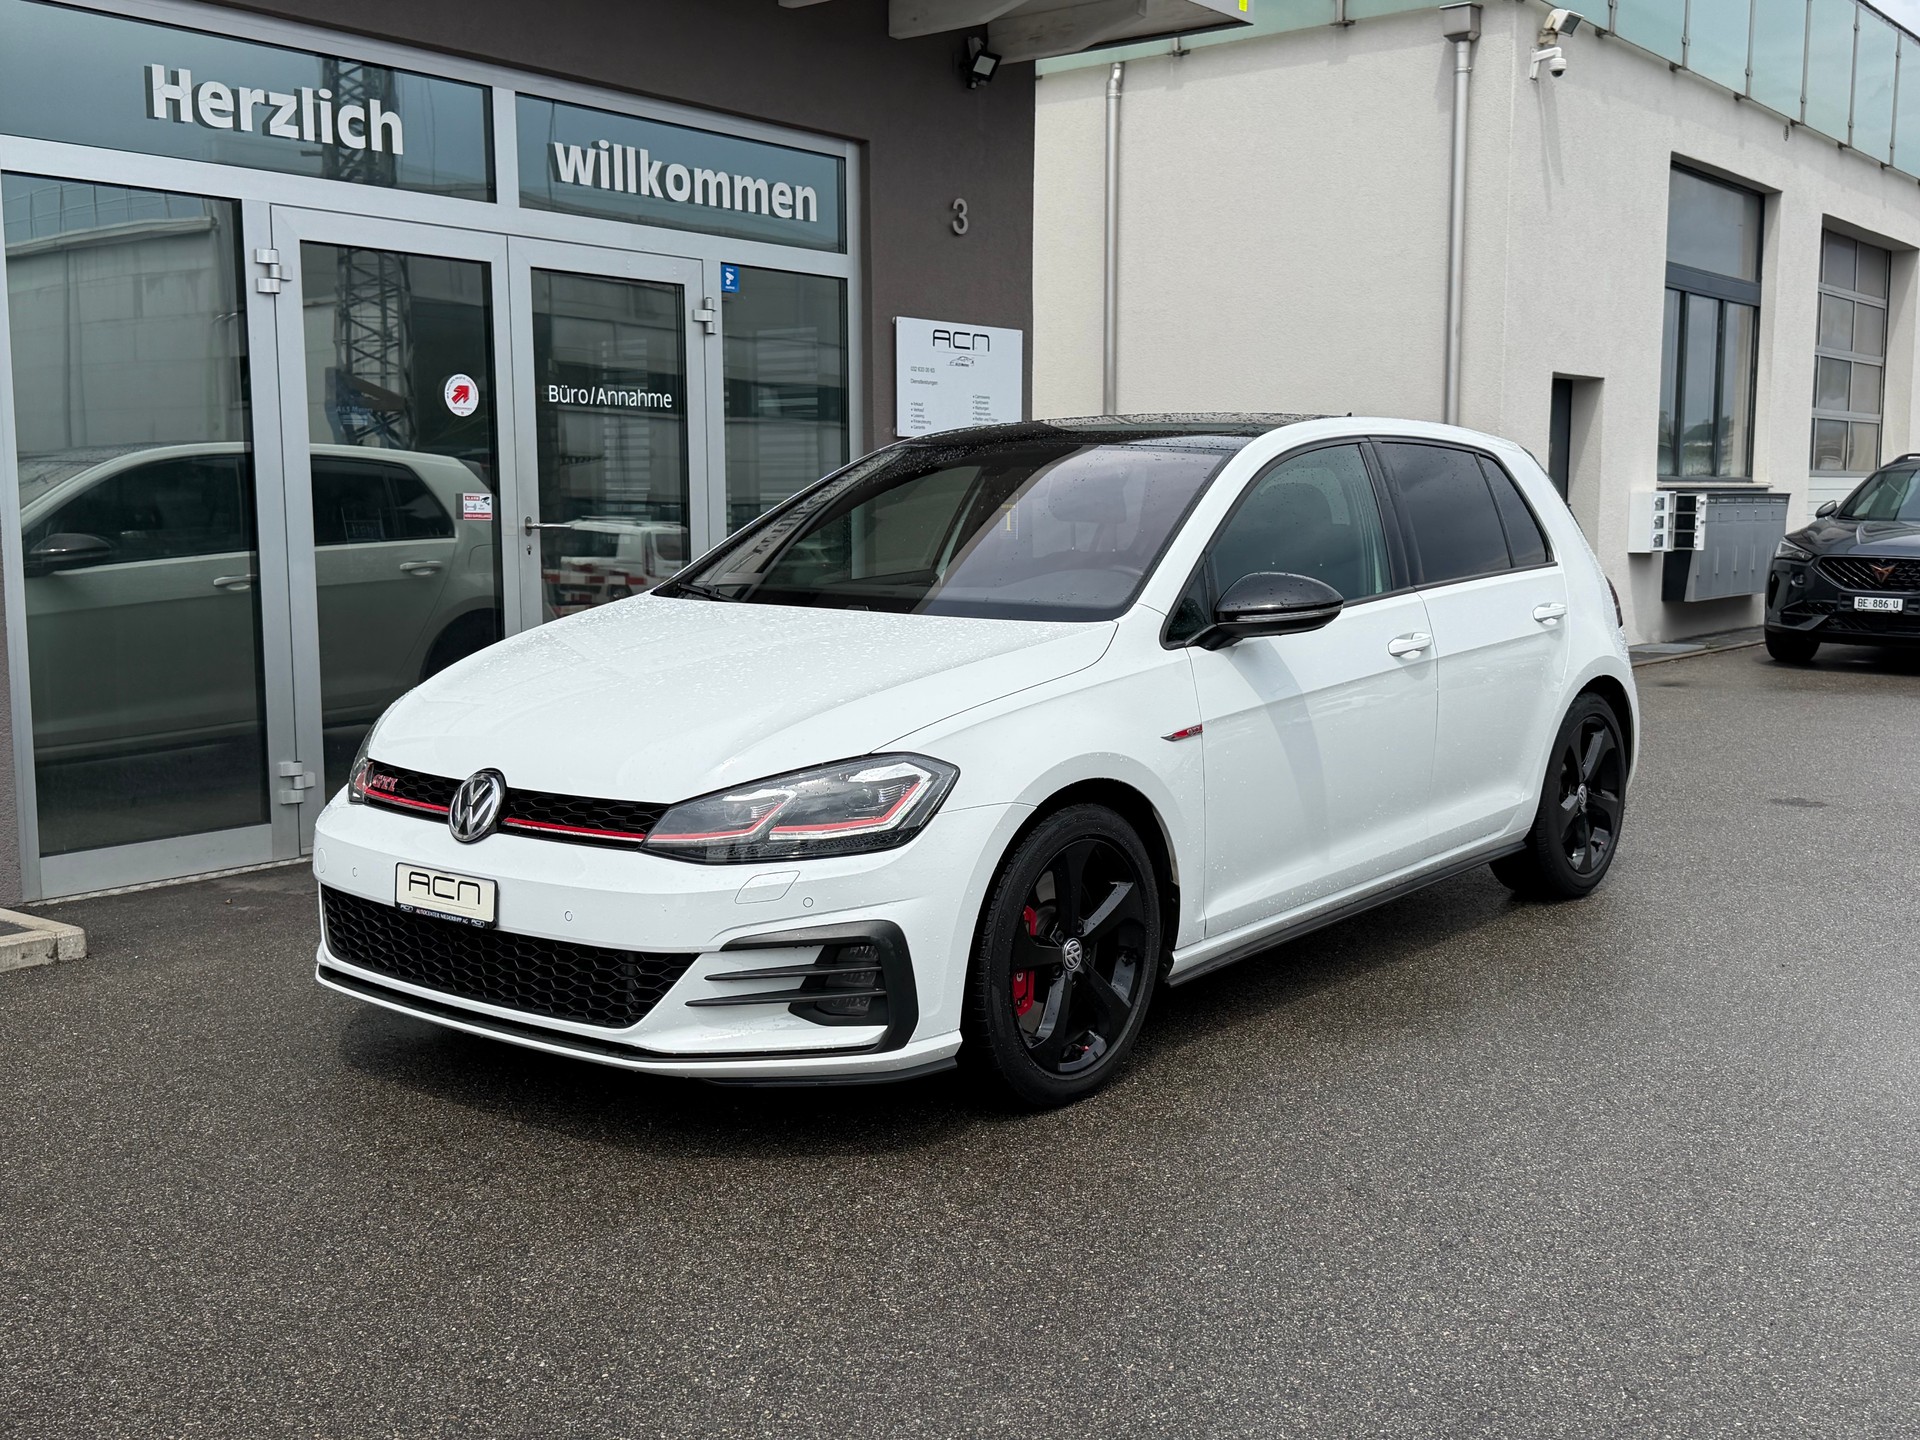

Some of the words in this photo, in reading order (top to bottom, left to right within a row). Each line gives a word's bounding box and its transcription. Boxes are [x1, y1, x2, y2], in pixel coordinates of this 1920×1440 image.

[150, 63, 404, 156] Herzlich
[554, 139, 818, 223] willkommen
[952, 198, 969, 235] 3
[932, 329, 990, 352] ACN
[547, 384, 673, 409] Büro/Annahme
[372, 774, 398, 791] GTI
[408, 871, 481, 905] ACN
[415, 908, 440, 918] AUTOCENTER
